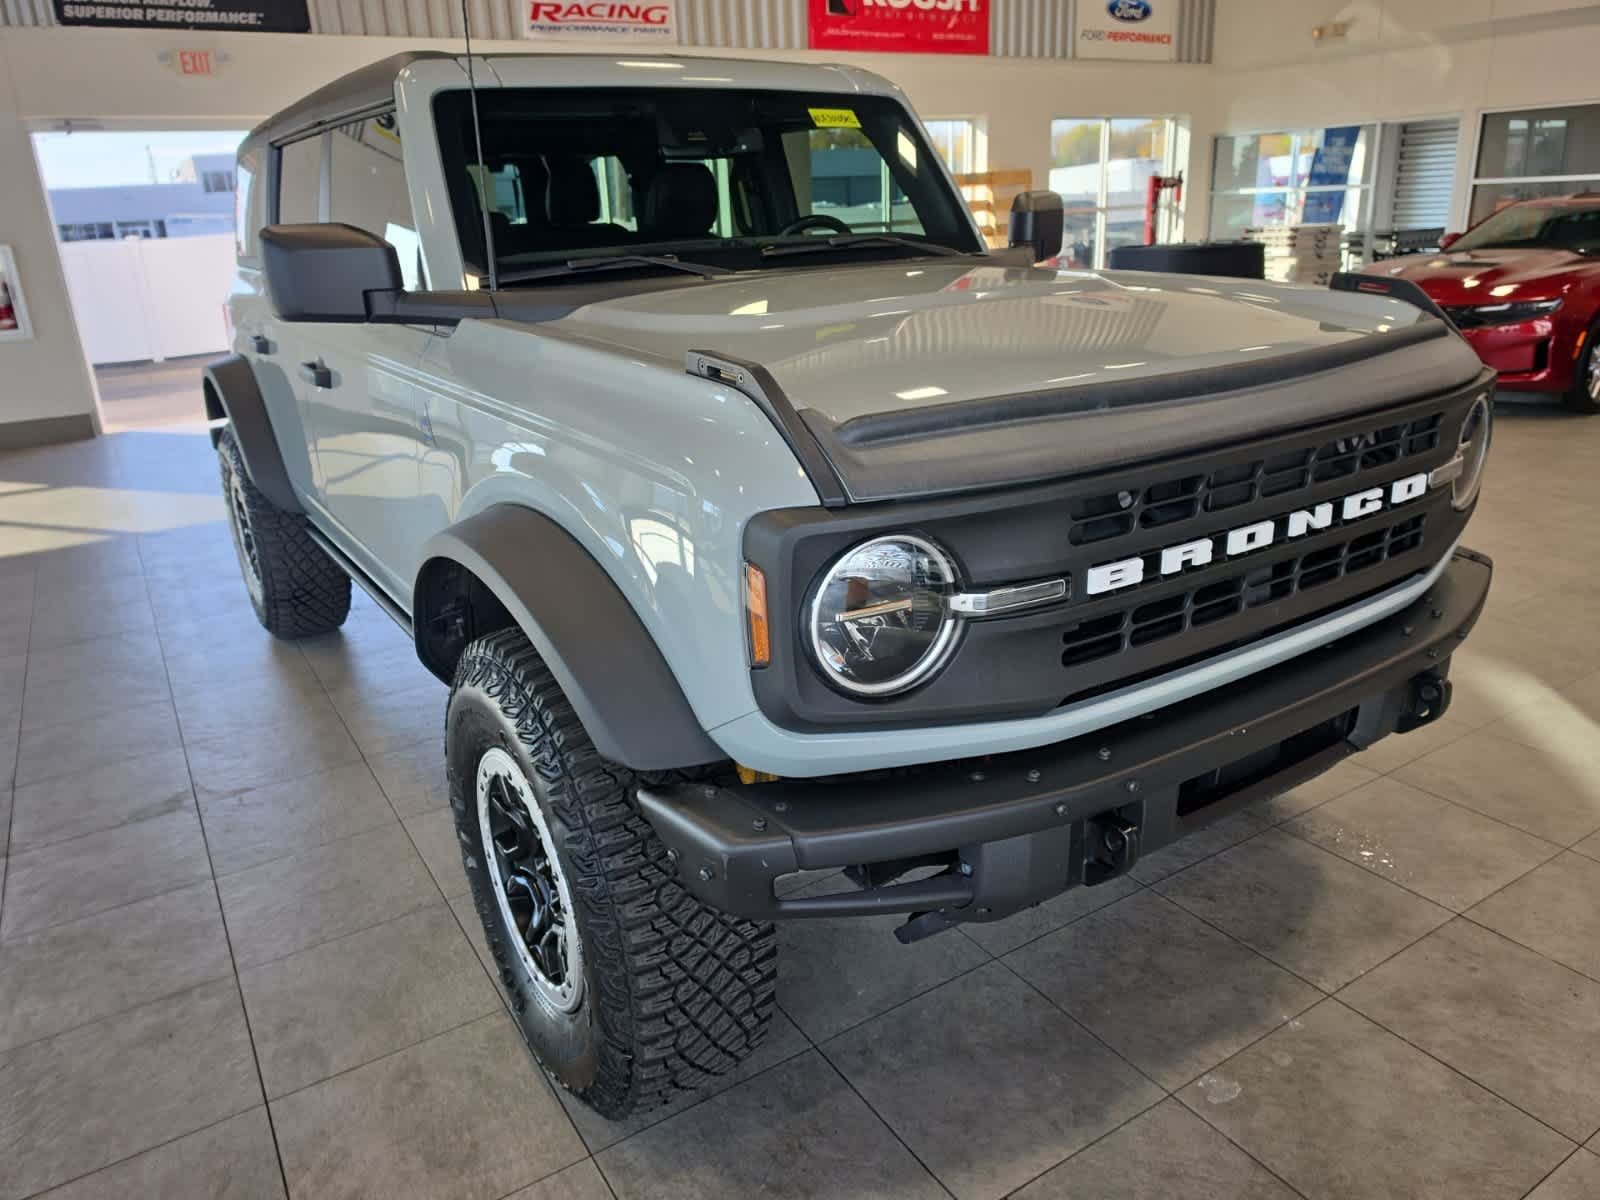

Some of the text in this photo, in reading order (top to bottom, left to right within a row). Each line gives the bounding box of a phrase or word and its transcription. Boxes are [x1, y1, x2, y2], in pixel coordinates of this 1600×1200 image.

[64, 5, 144, 20] SUPERIOR
[530, 2, 669, 24] RACING
[530, 24, 628, 32] PERFORMANCE
[1081, 30, 1105, 40] FORD
[180, 51, 210, 74] EXIT
[1087, 473, 1427, 595] BRONCO
